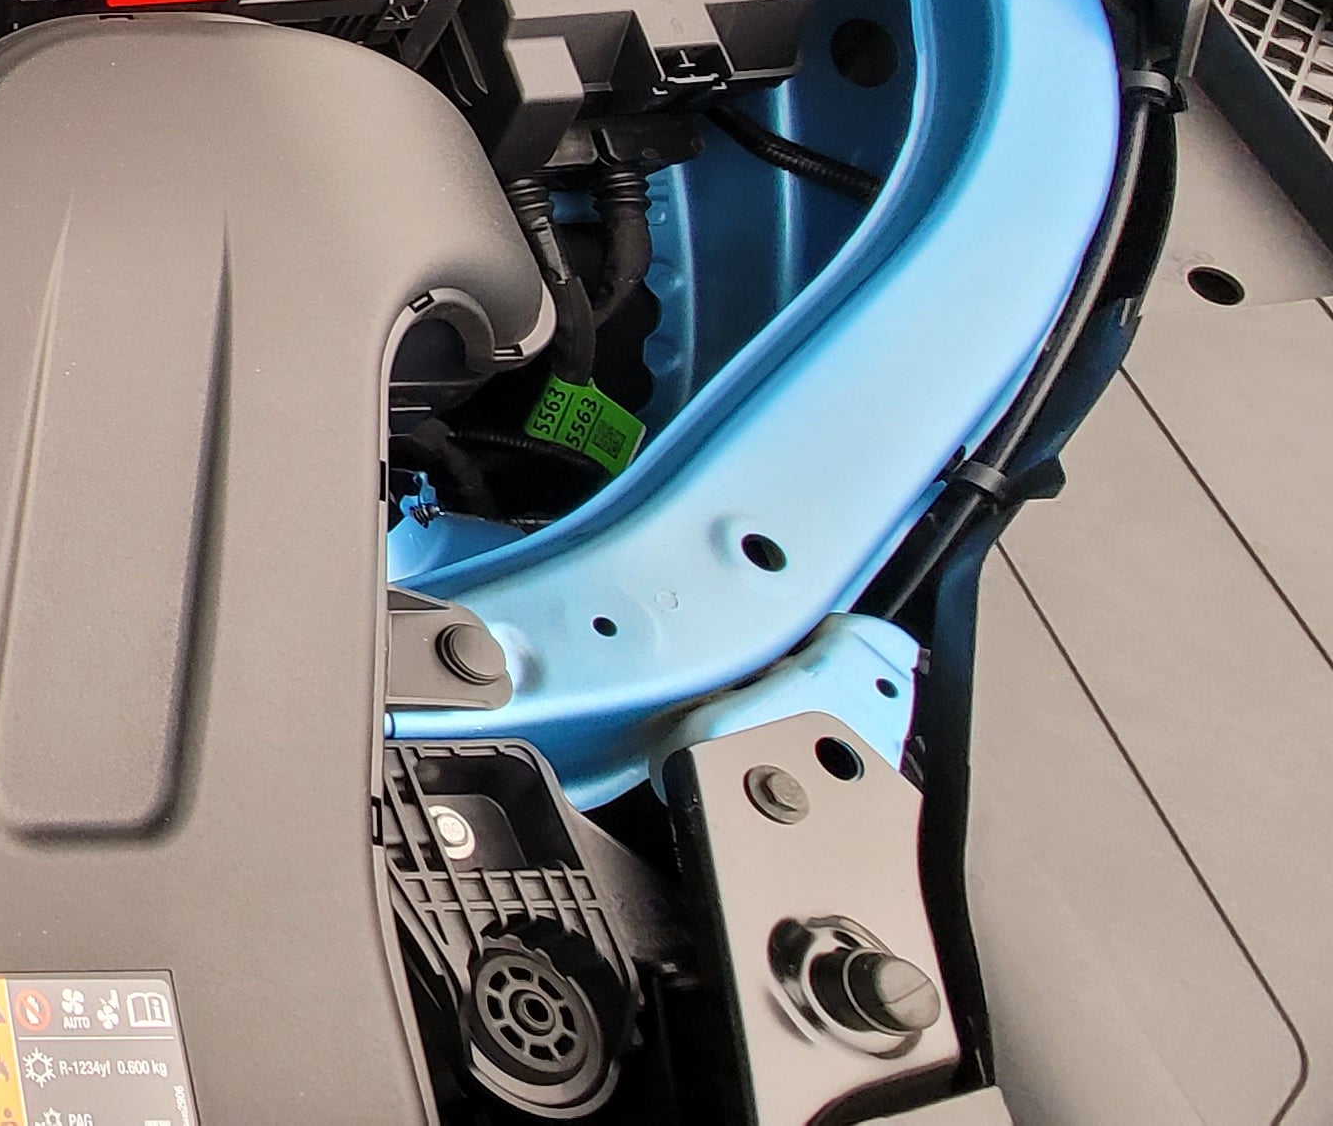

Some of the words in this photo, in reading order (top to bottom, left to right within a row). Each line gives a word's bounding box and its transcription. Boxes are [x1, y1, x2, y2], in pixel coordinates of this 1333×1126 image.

[533, 386, 566, 435] 5563
[564, 397, 597, 448] 5563
[63, 1016, 91, 1029] AUTO
[117, 1061, 151, 1076] 0.600
[151, 1060, 168, 1078] kg
[67, 1113, 94, 1126] PAG
